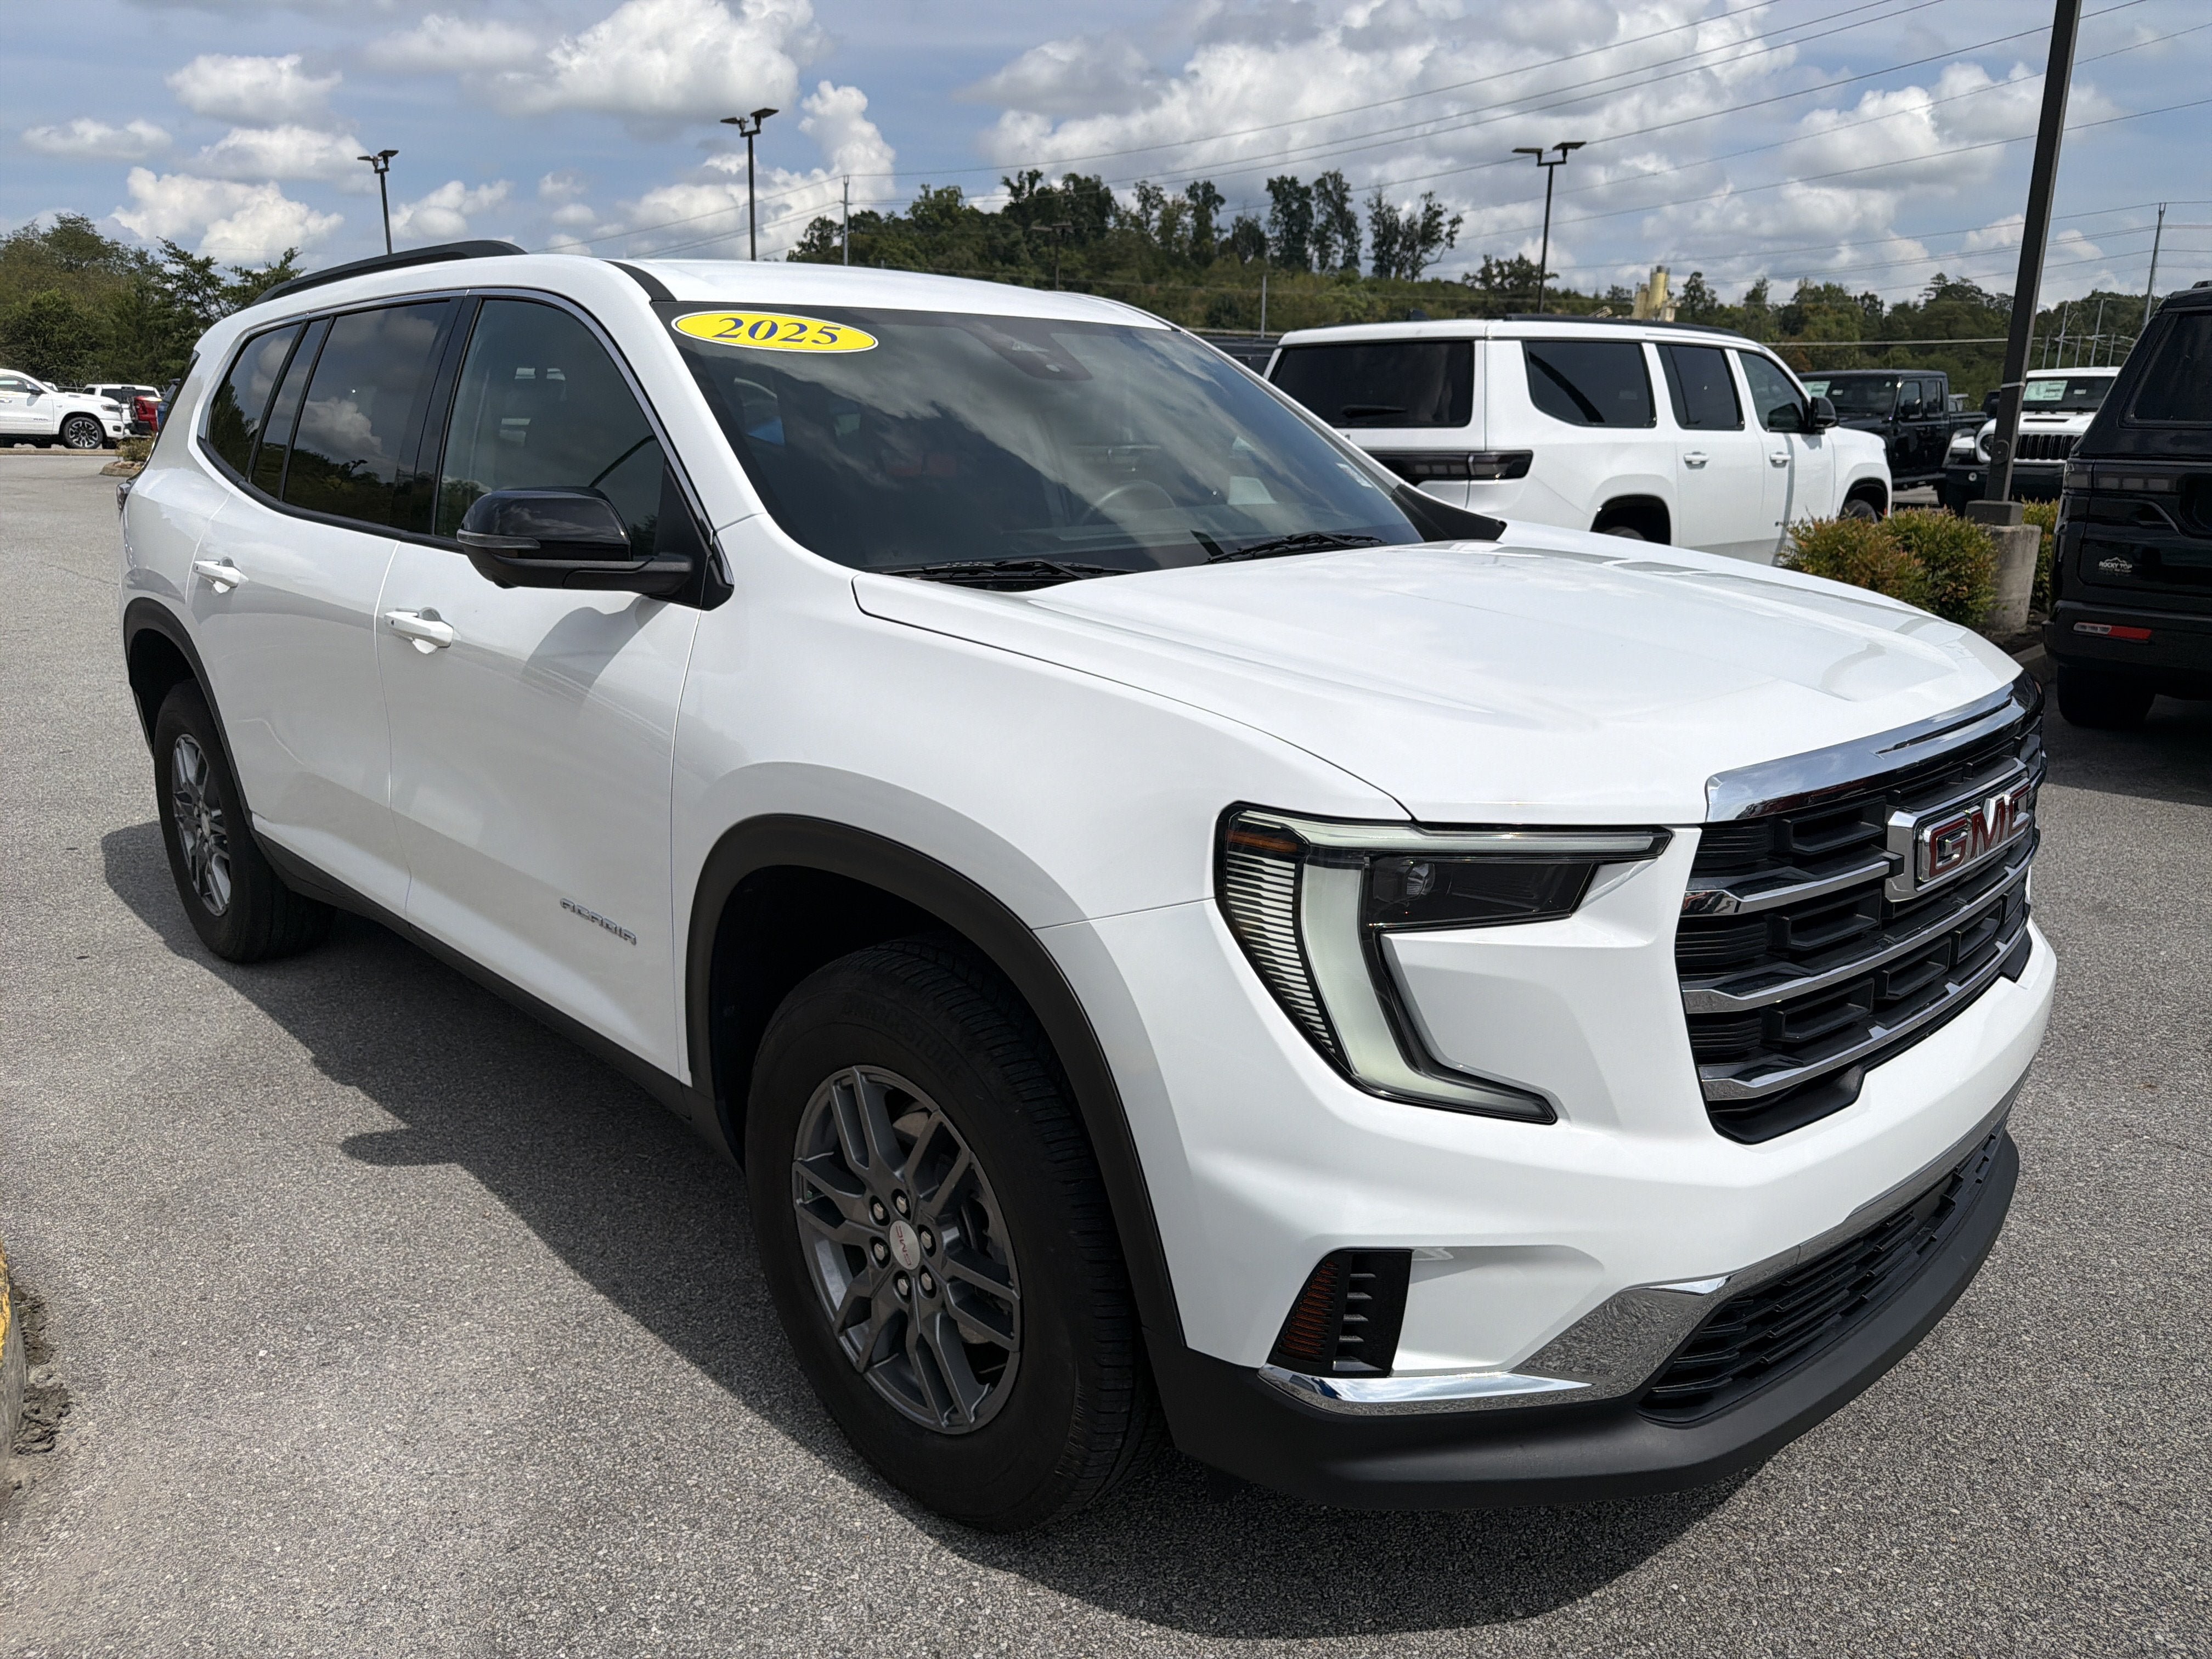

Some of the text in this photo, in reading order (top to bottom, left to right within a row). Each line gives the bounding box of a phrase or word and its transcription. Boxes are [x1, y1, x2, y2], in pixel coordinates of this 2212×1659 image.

[712, 318, 841, 345] 2025
[1923, 778, 2031, 881] GMC
[560, 898, 636, 945] ACADIA
[896, 1224, 911, 1266] GMC
